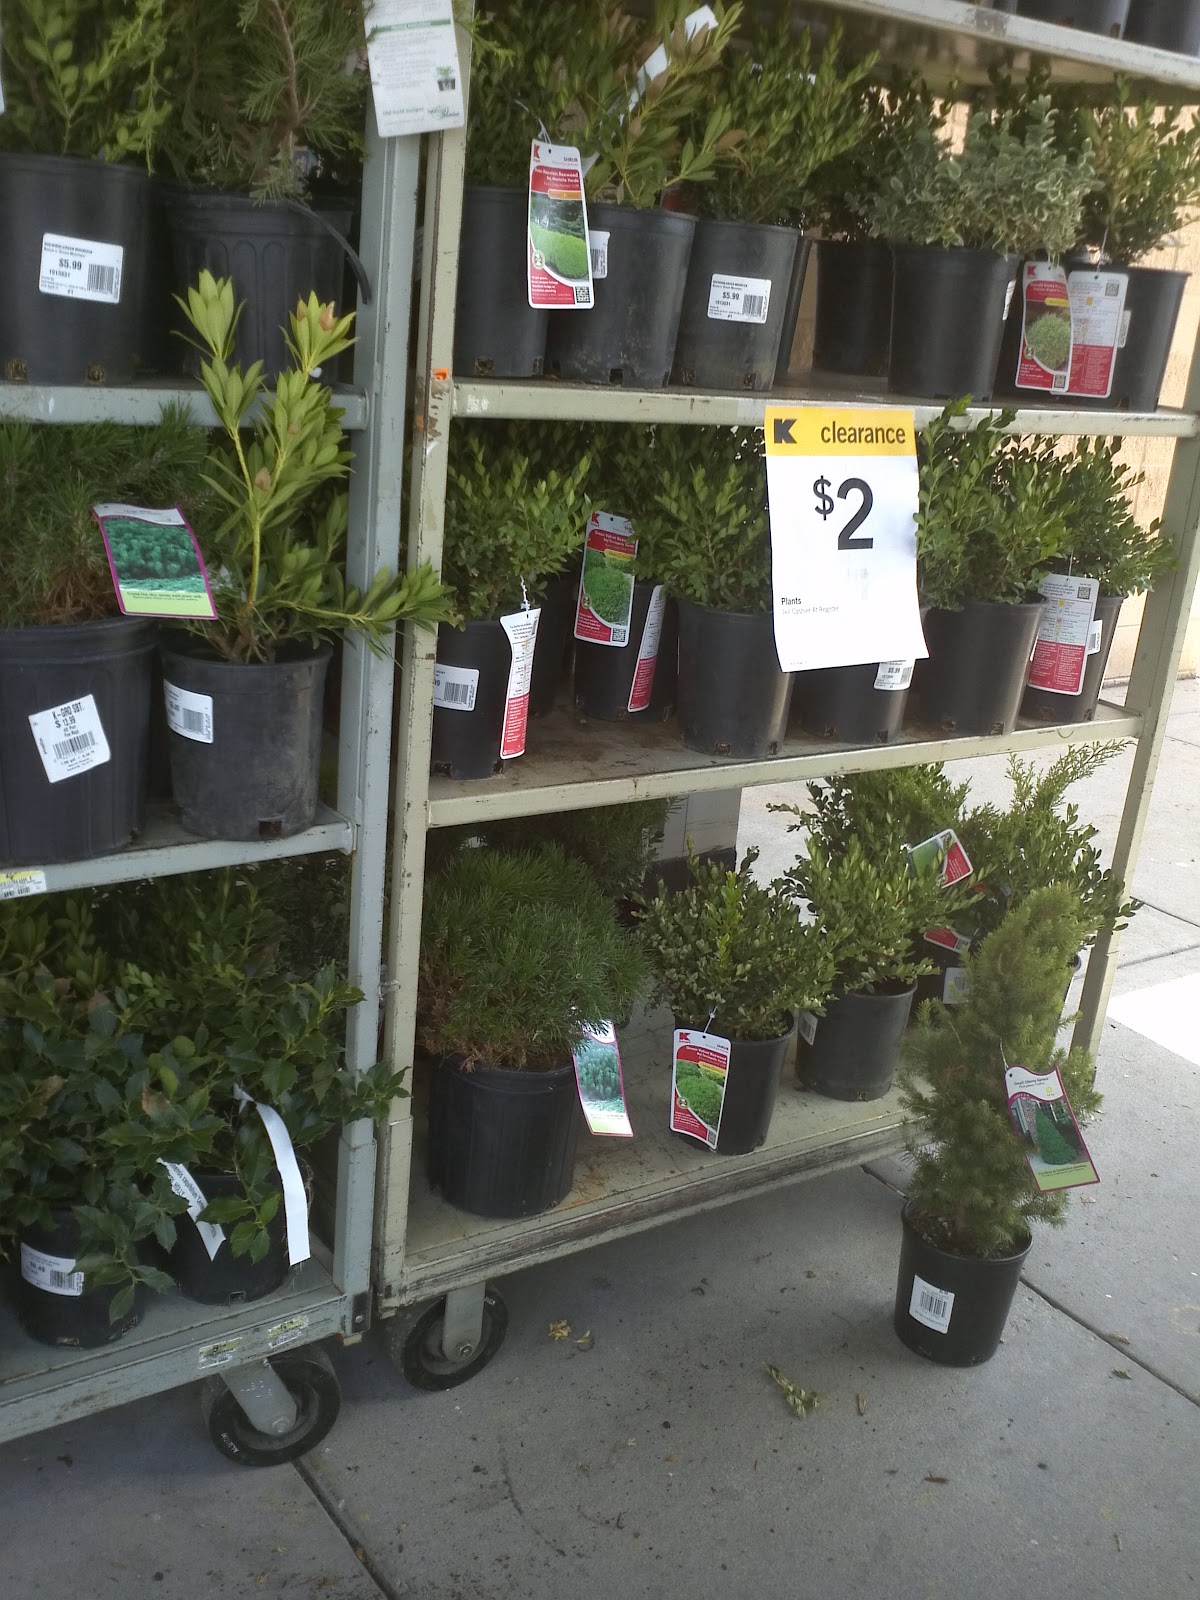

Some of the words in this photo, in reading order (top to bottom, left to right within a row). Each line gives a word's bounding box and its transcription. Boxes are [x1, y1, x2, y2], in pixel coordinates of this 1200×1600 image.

[59, 258, 82, 271] $5.99
[722, 291, 740, 301] $5.99
[773, 418, 798, 444] K
[820, 421, 906, 445] clearance
[812, 475, 874, 551] $2
[781, 597, 802, 606] Plants
